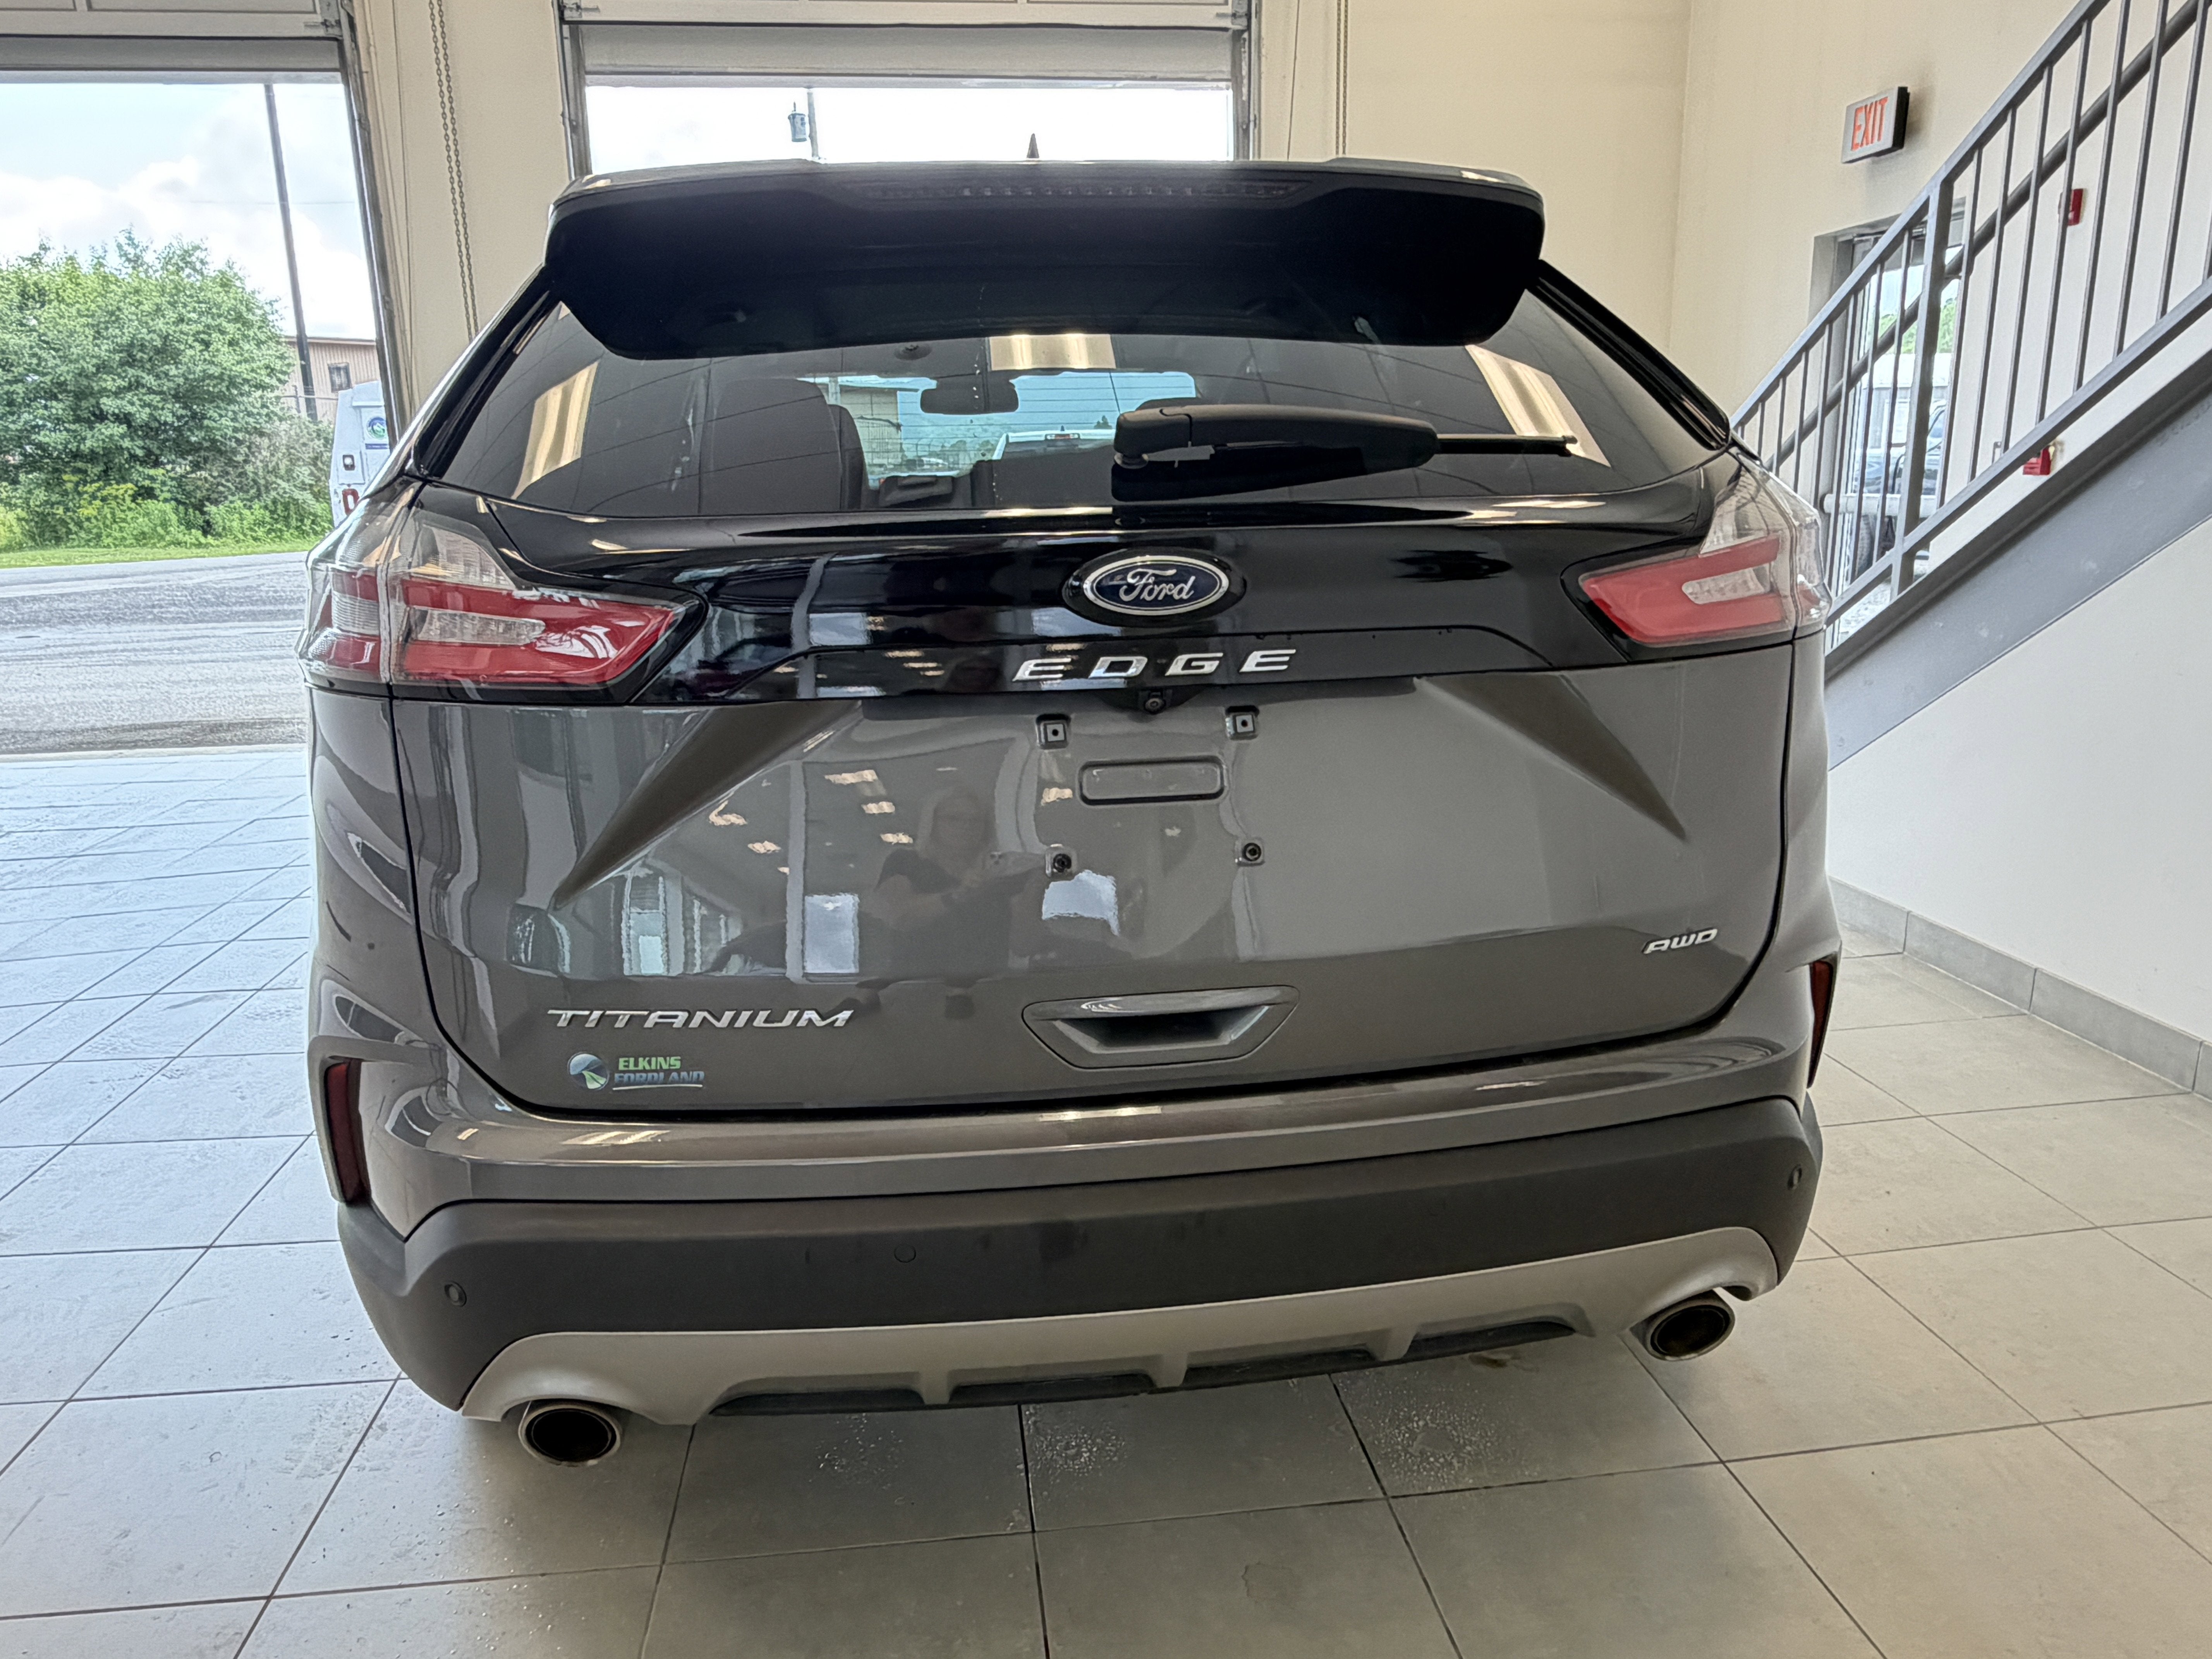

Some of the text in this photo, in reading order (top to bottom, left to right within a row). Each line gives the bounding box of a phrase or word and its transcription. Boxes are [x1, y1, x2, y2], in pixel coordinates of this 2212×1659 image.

[1851, 96, 1888, 151] EXIT
[1119, 568, 1195, 602] Ford
[1012, 649, 1297, 682] EDGE
[1643, 929, 1718, 954] AWD
[547, 1010, 854, 1028] TITANIUM
[618, 1056, 681, 1070] ELKINS
